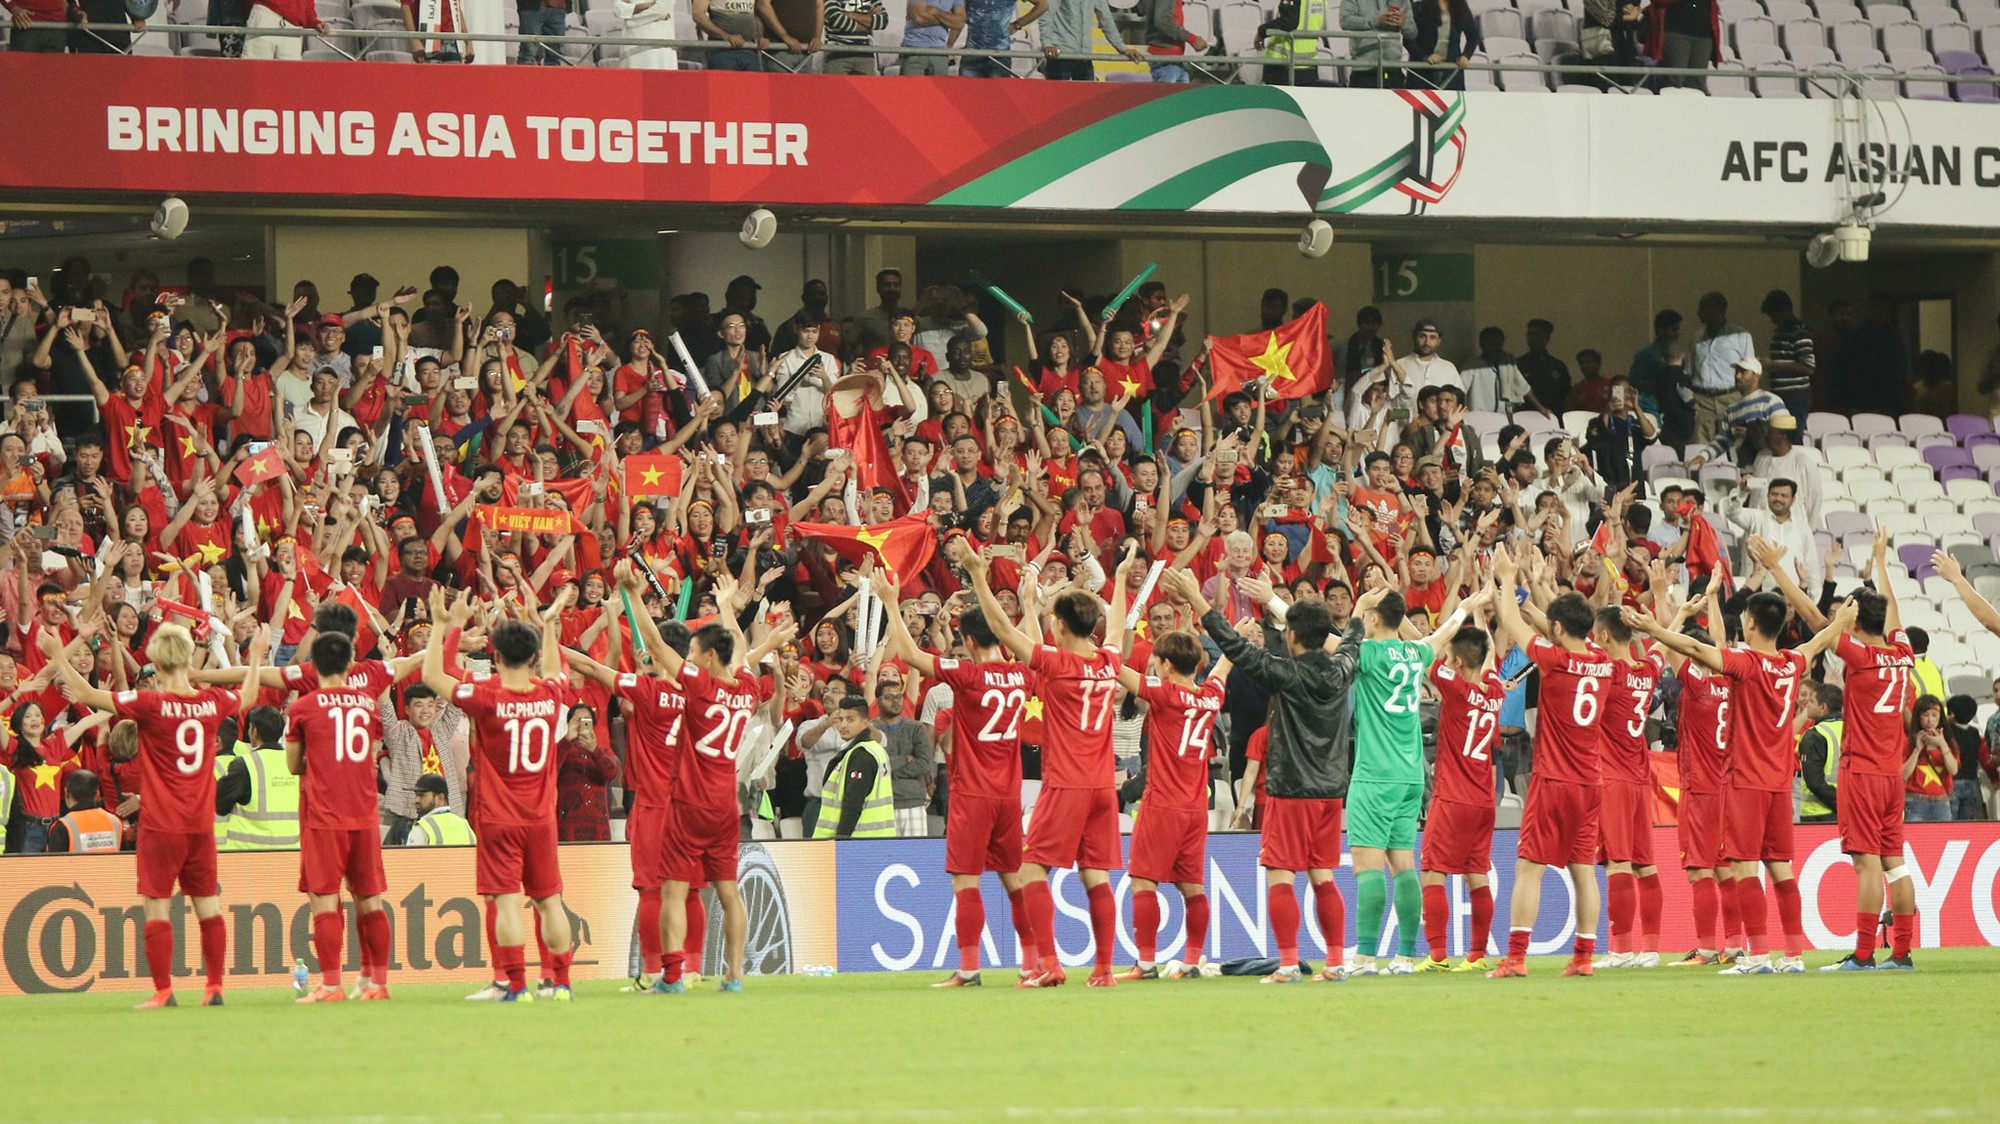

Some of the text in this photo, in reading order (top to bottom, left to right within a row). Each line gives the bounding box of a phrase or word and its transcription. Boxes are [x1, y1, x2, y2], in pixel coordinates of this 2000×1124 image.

[108, 105, 808, 166] BRINGING ASIA TOGETHER
[1721, 141, 1808, 182] AFC
[1825, 142, 1961, 185] ASIAN
[558, 246, 597, 284] 15
[1380, 260, 1418, 296] 15
[532, 516, 555, 530] NAM
[161, 700, 218, 718] N.V.TOAN
[316, 693, 376, 712] D.H.DUNG
[496, 699, 556, 718] N.C.PHUONG
[1079, 679, 1116, 731] 17
[1384, 662, 1423, 713] 23
[1573, 676, 1599, 727] 6
[1775, 677, 1794, 728] 7
[1873, 666, 1908, 714] 21
[328, 706, 371, 763] 16
[695, 703, 752, 760] 20
[977, 688, 1026, 742] 22
[1178, 708, 1212, 760] 14
[1462, 708, 1496, 761] 12
[1627, 690, 1650, 738] 3
[176, 718, 204, 773] 9
[504, 717, 550, 774] 10
